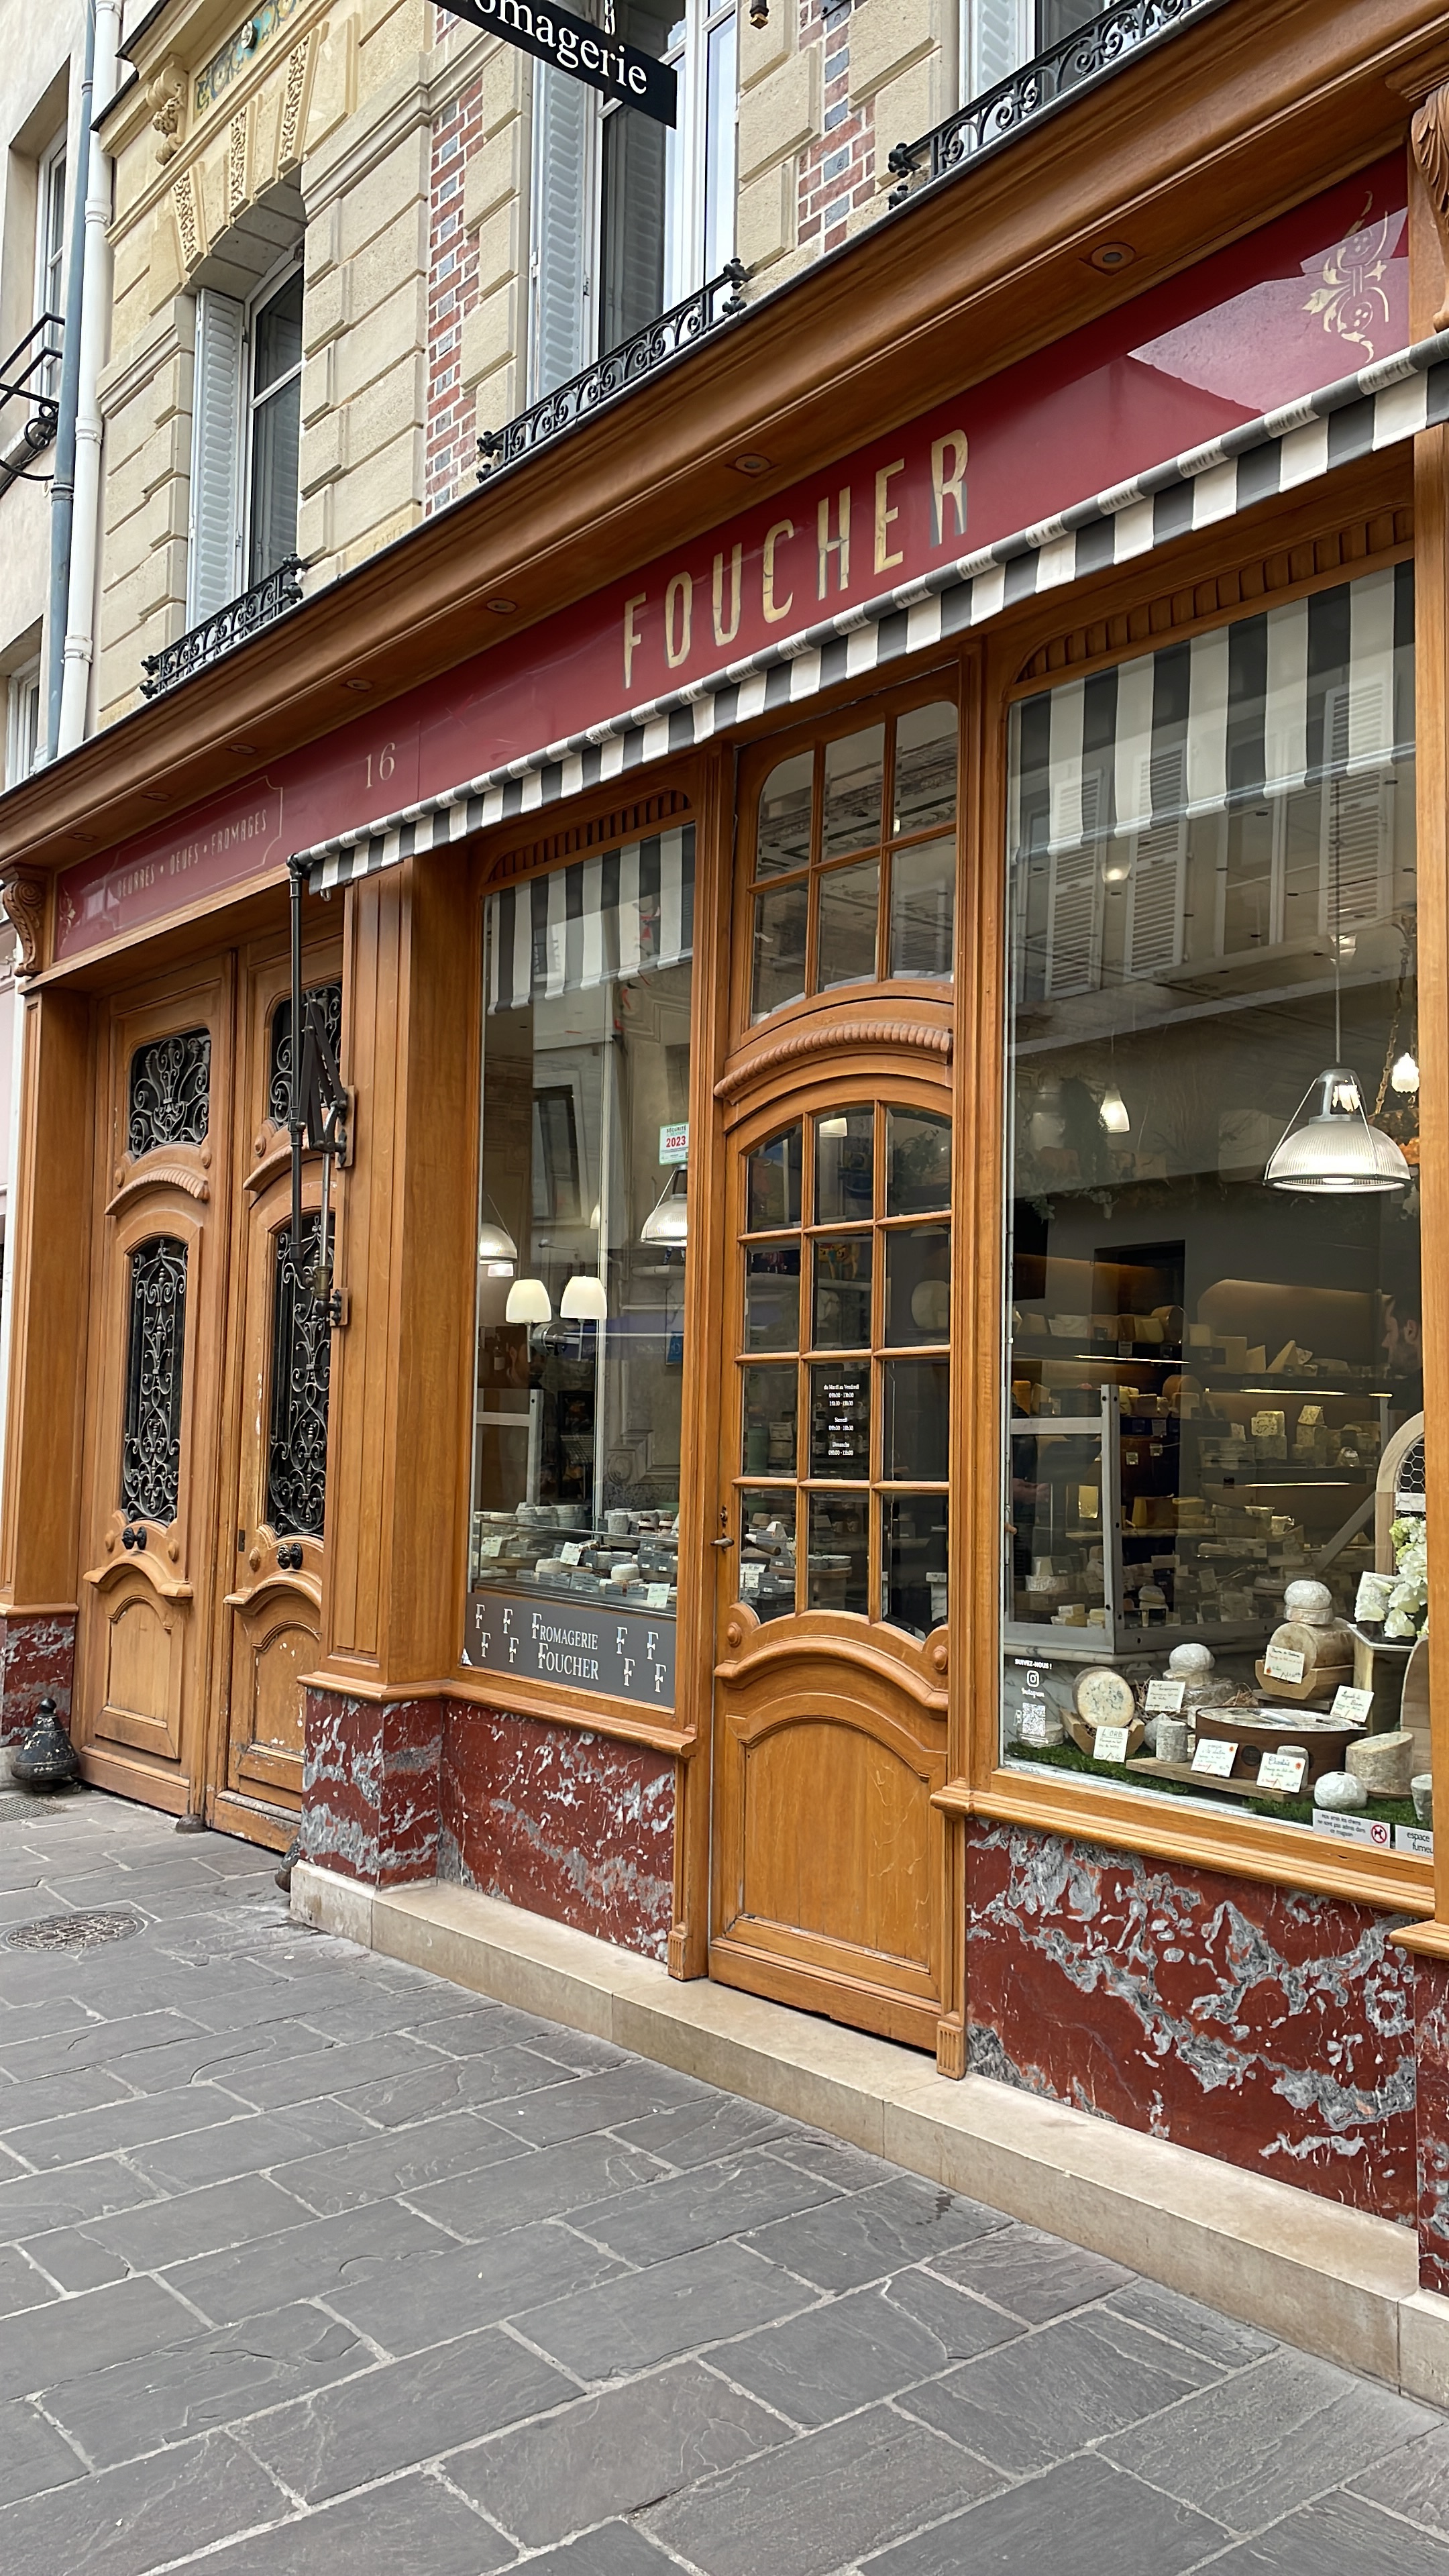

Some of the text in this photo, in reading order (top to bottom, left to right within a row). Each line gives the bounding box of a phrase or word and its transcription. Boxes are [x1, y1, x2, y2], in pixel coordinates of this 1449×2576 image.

[623, 429, 969, 690] FOUCHER
[365, 742, 395, 789] 16
[117, 863, 154, 899] BEURRES
[211, 809, 267, 855] FROMAGES
[666, 1135, 686, 1148] 2023
[532, 1613, 598, 1650] FROMAGERIE
[538, 1642, 599, 1680] FOUCHER
[1407, 1832, 1430, 1843] espace
